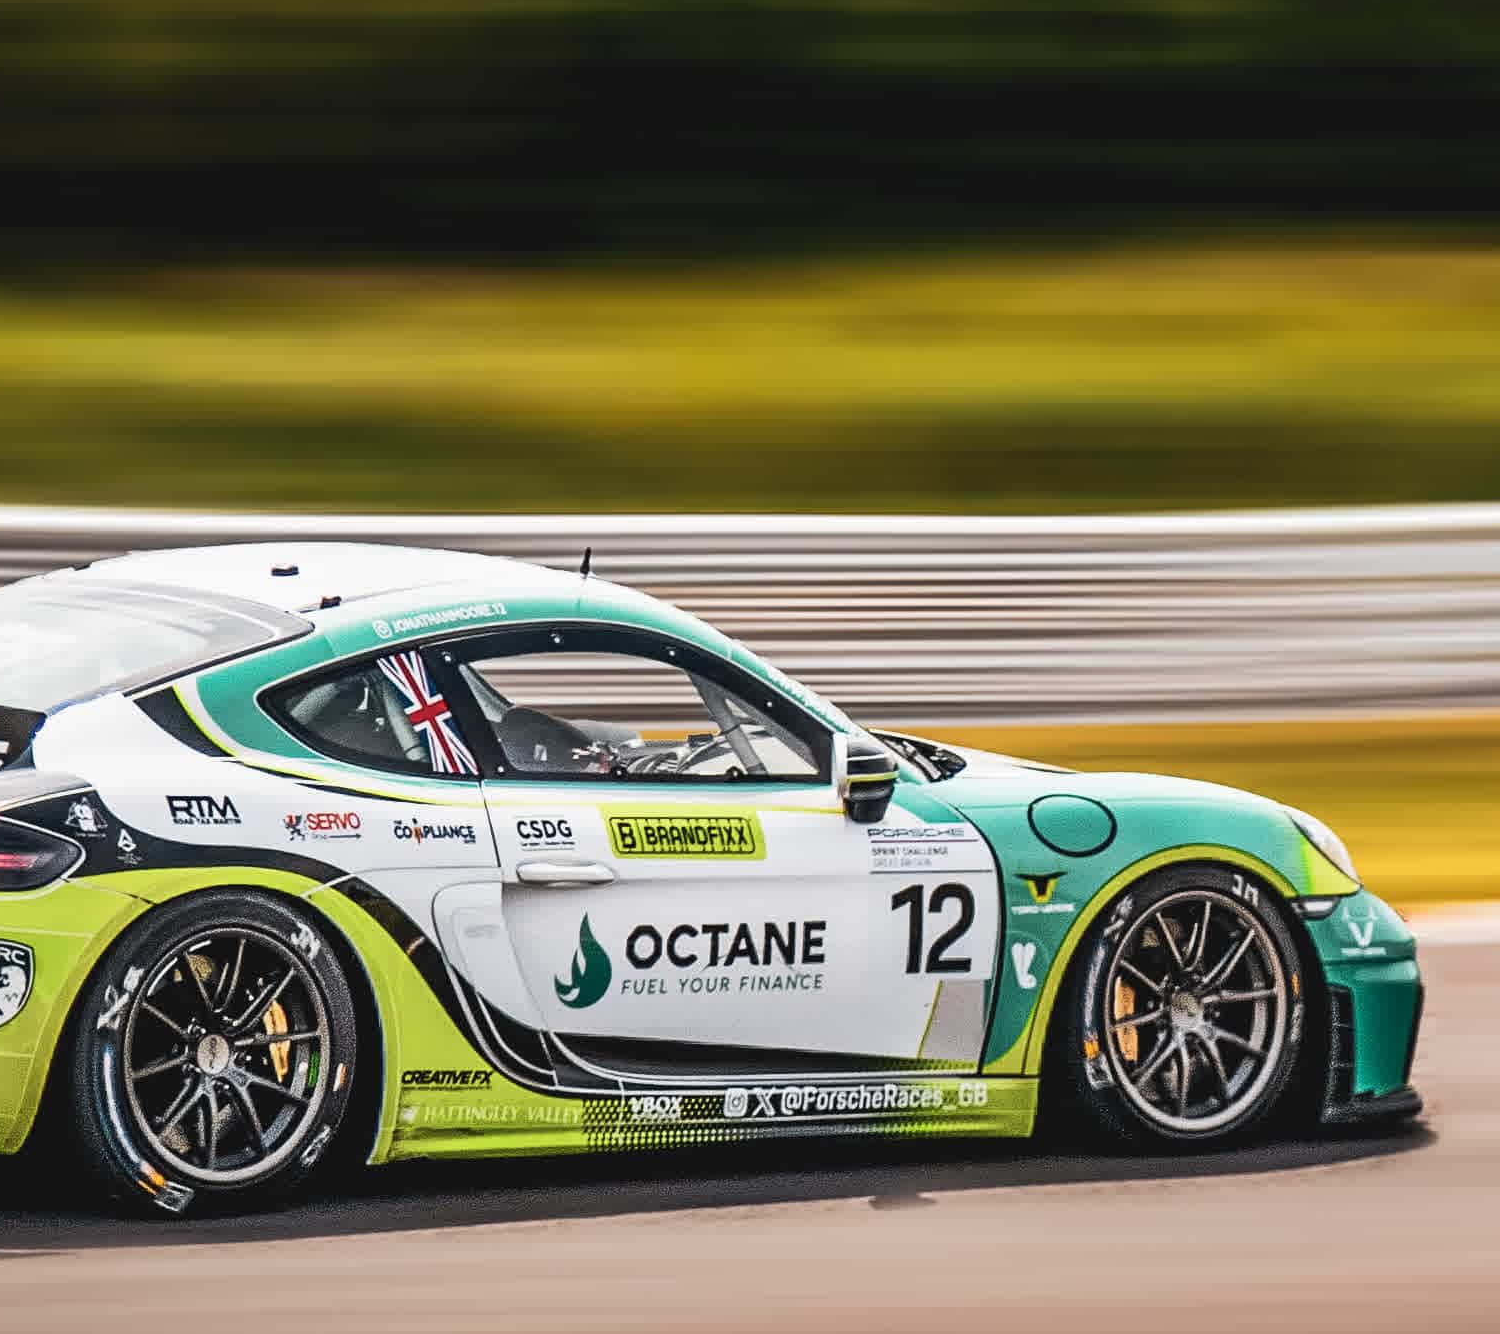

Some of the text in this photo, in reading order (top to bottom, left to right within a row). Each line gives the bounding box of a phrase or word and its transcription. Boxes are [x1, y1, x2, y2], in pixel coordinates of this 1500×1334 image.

[166, 795, 239, 818] RTM
[306, 812, 361, 830] SERVO
[517, 819, 573, 839] CSDG
[644, 825, 749, 845] BRANDFIXX
[868, 828, 965, 837] PORSCHE
[891, 882, 976, 974] 12
[625, 920, 827, 970] OCTANE
[620, 973, 824, 995] FUEL YOUR FINANCE
[401, 1070, 493, 1085] CREATIVE FX
